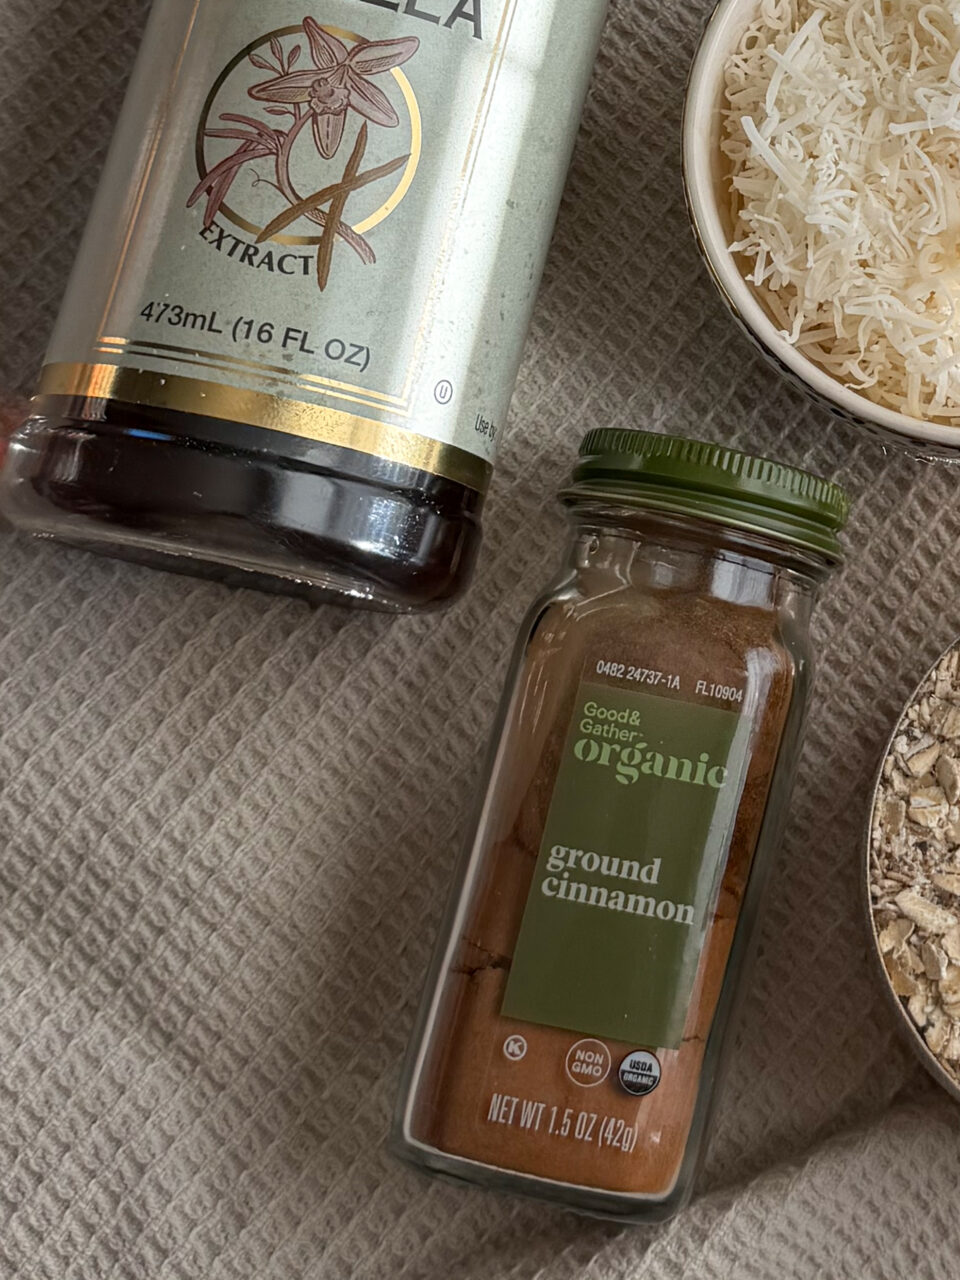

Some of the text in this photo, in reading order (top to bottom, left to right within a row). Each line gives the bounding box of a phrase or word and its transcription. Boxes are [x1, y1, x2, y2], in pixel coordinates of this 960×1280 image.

[199, 222, 314, 276] EXTRACT
[140, 301, 371, 373] 473mL (16 FL OZ)
[475, 413, 489, 435] Use
[596, 660, 743, 703] 0482 24737-1A FL10904
[580, 718, 638, 742] Gather
[584, 701, 640, 726] Good&
[573, 738, 729, 789] organic
[546, 844, 663, 885] ground
[541, 871, 695, 926] cinnamon
[571, 1061, 603, 1077] GMO
[575, 1049, 604, 1064] NON
[629, 1059, 653, 1073] USDA
[488, 1092, 639, 1153] NET WT 1.5 OZ (42g)
